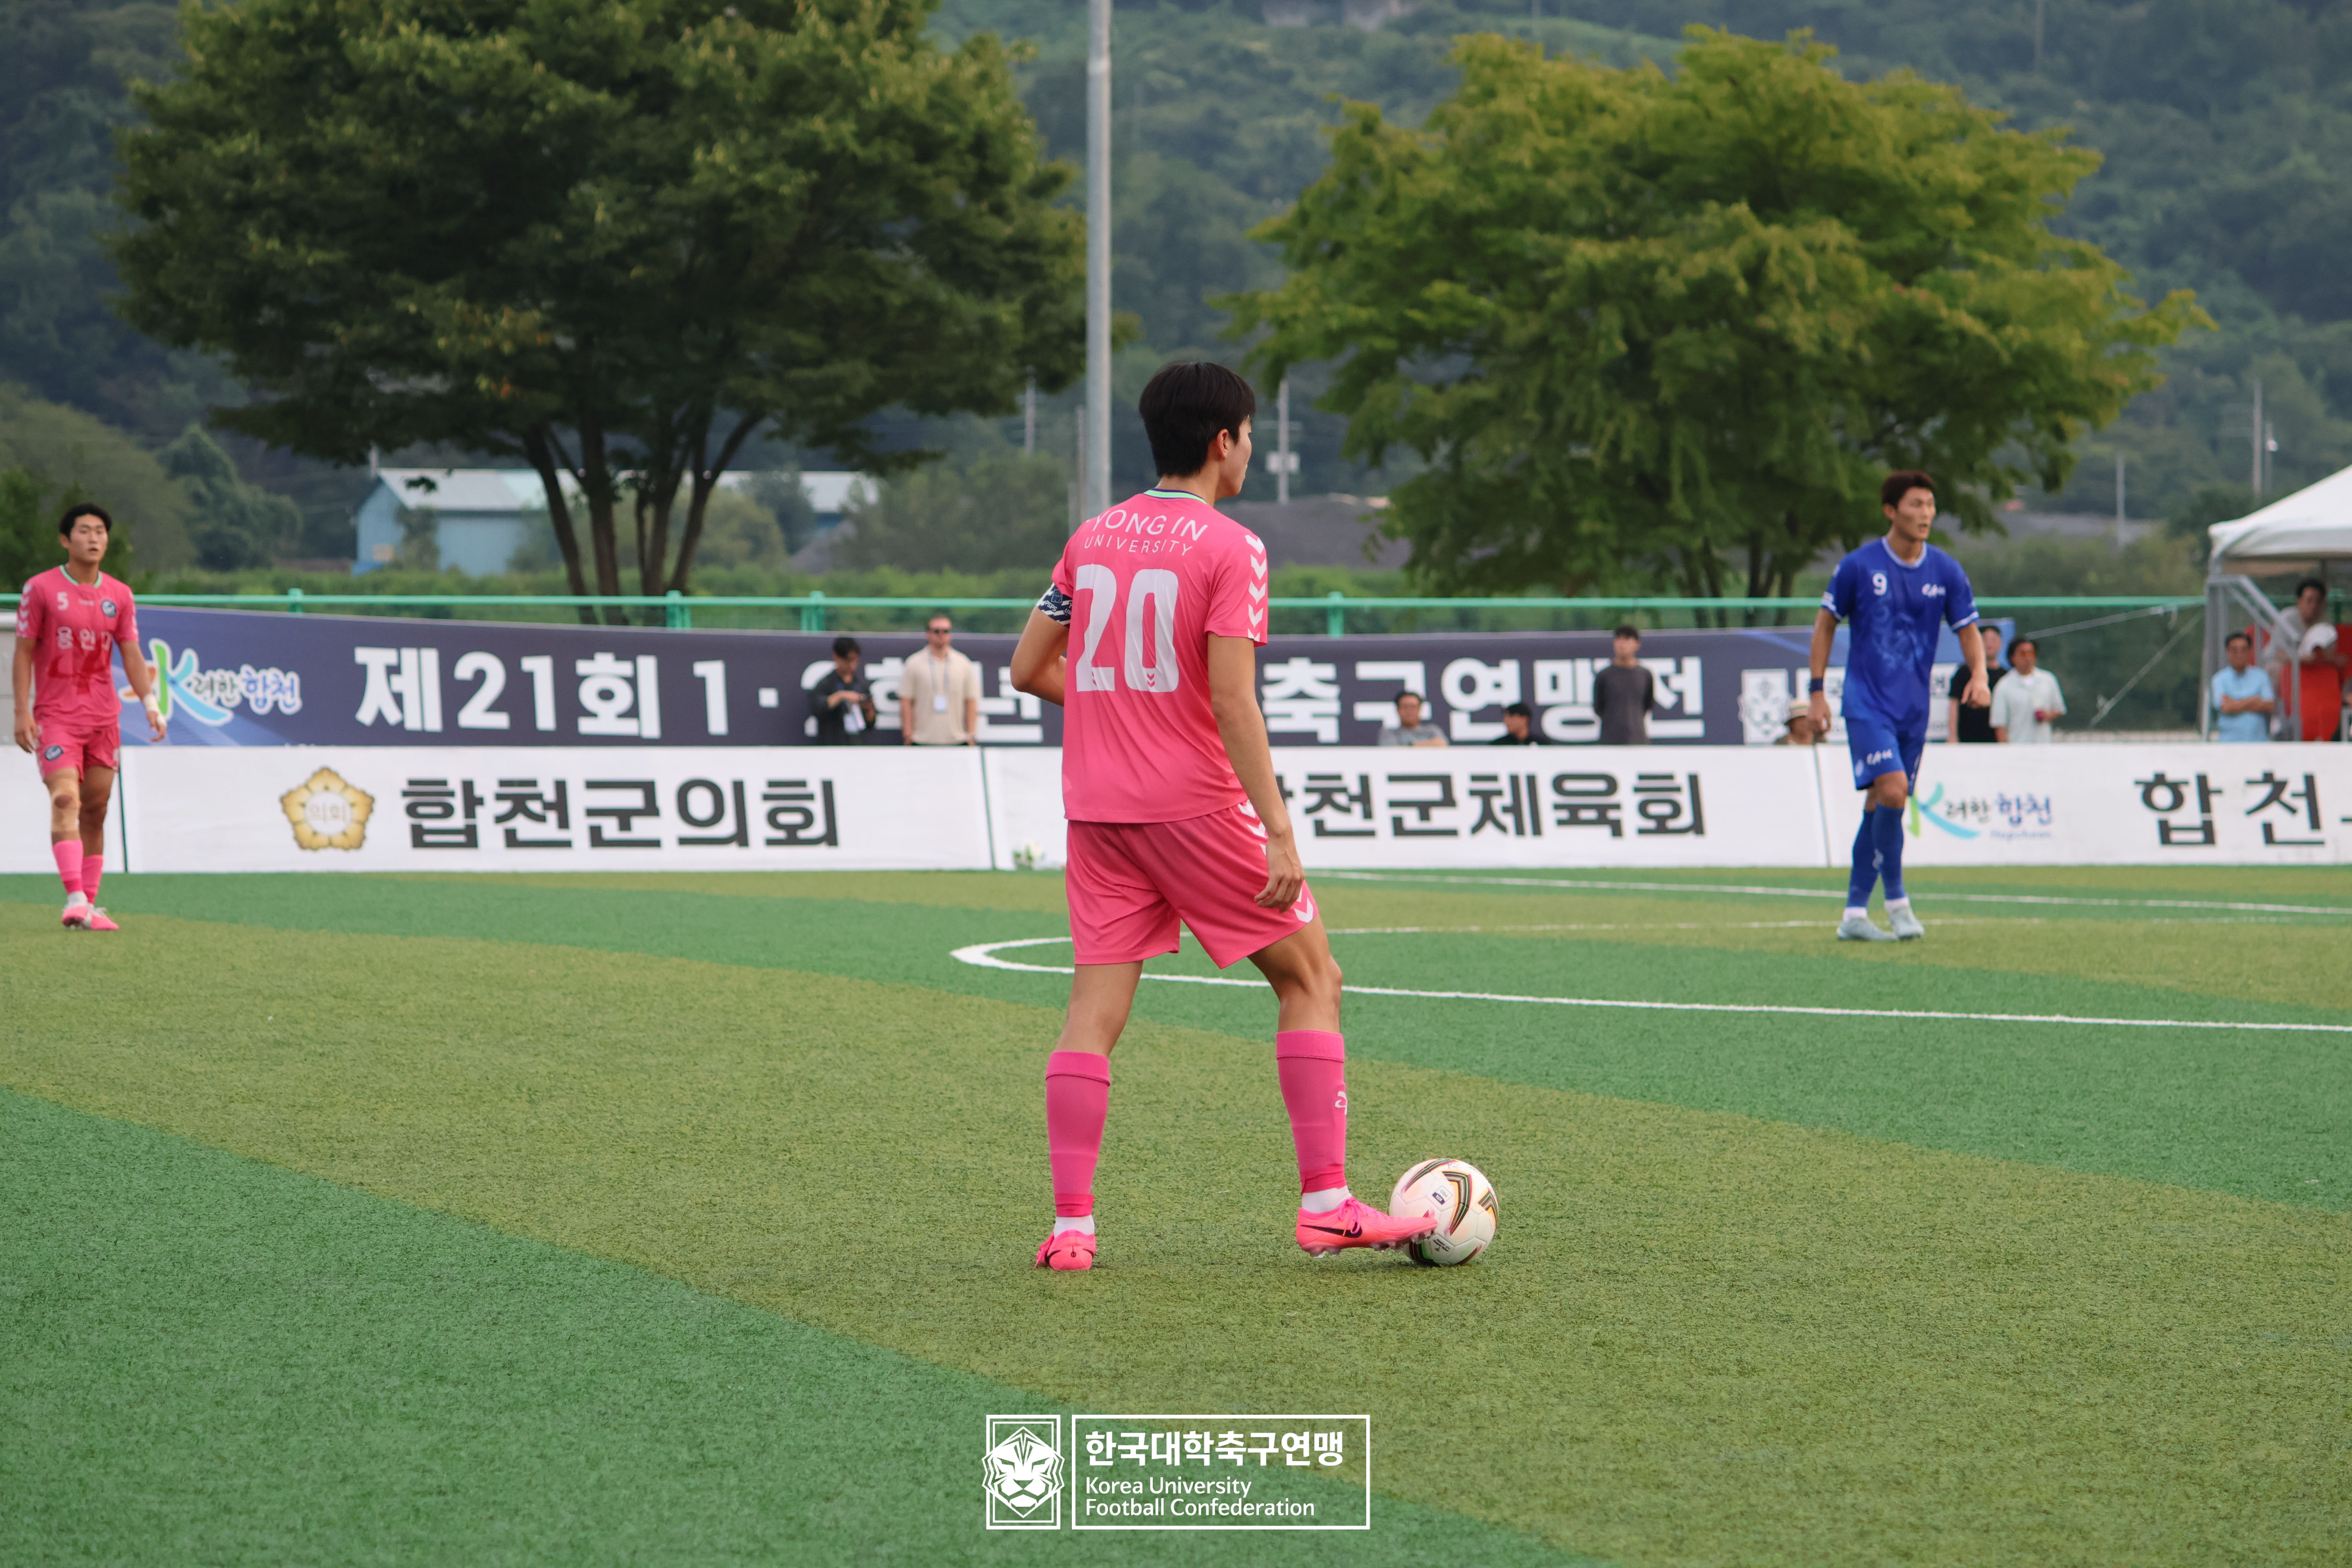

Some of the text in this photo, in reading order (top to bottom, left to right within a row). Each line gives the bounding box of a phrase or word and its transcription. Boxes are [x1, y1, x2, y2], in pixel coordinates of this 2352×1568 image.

[1084, 534, 1193, 556] UNIVERSITY
[57, 592, 69, 610] 5
[1872, 573, 1887, 595] 9
[1075, 563, 1179, 693] 20
[241, 667, 297, 709] 합천
[354, 647, 661, 739] 제21회
[401, 778, 838, 849] 합천군의회
[1277, 773, 1705, 838] 천군체육회
[1996, 791, 2053, 827] 합천
[2134, 771, 2352, 846] 합천
[1440, 1189, 1448, 1198] PRO
